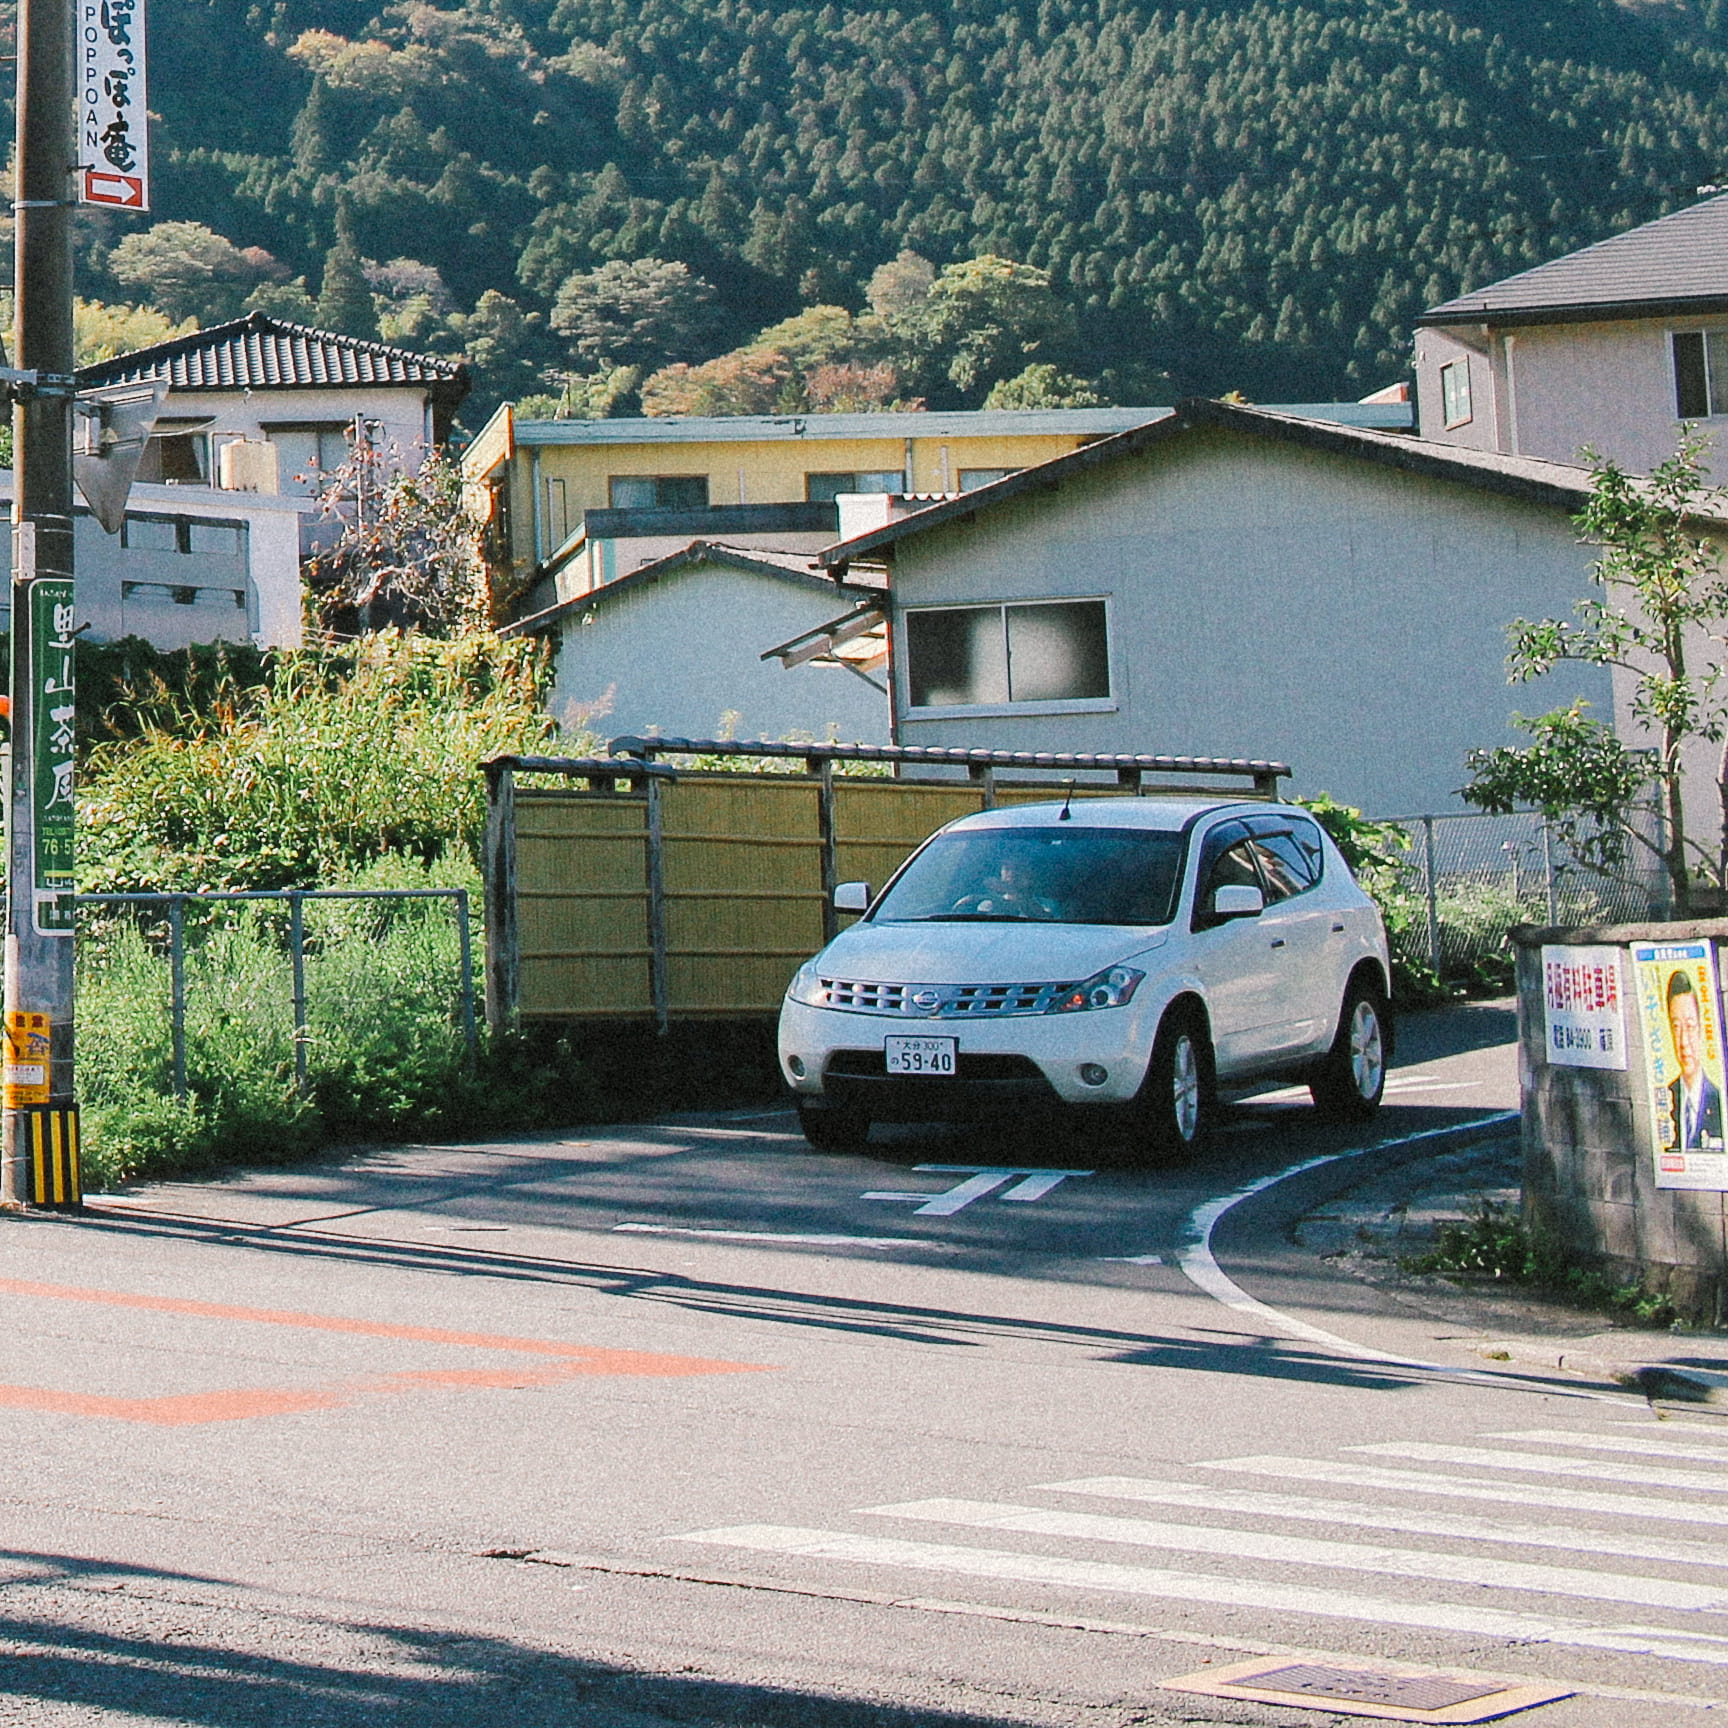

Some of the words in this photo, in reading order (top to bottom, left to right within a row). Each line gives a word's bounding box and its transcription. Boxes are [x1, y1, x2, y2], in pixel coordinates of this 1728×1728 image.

[85, 6, 98, 147] POPPOAN
[903, 1041, 920, 1050] 大分
[924, 1042, 939, 1050] 300
[891, 1057, 899, 1065] の
[902, 1053, 951, 1071] 59-40
